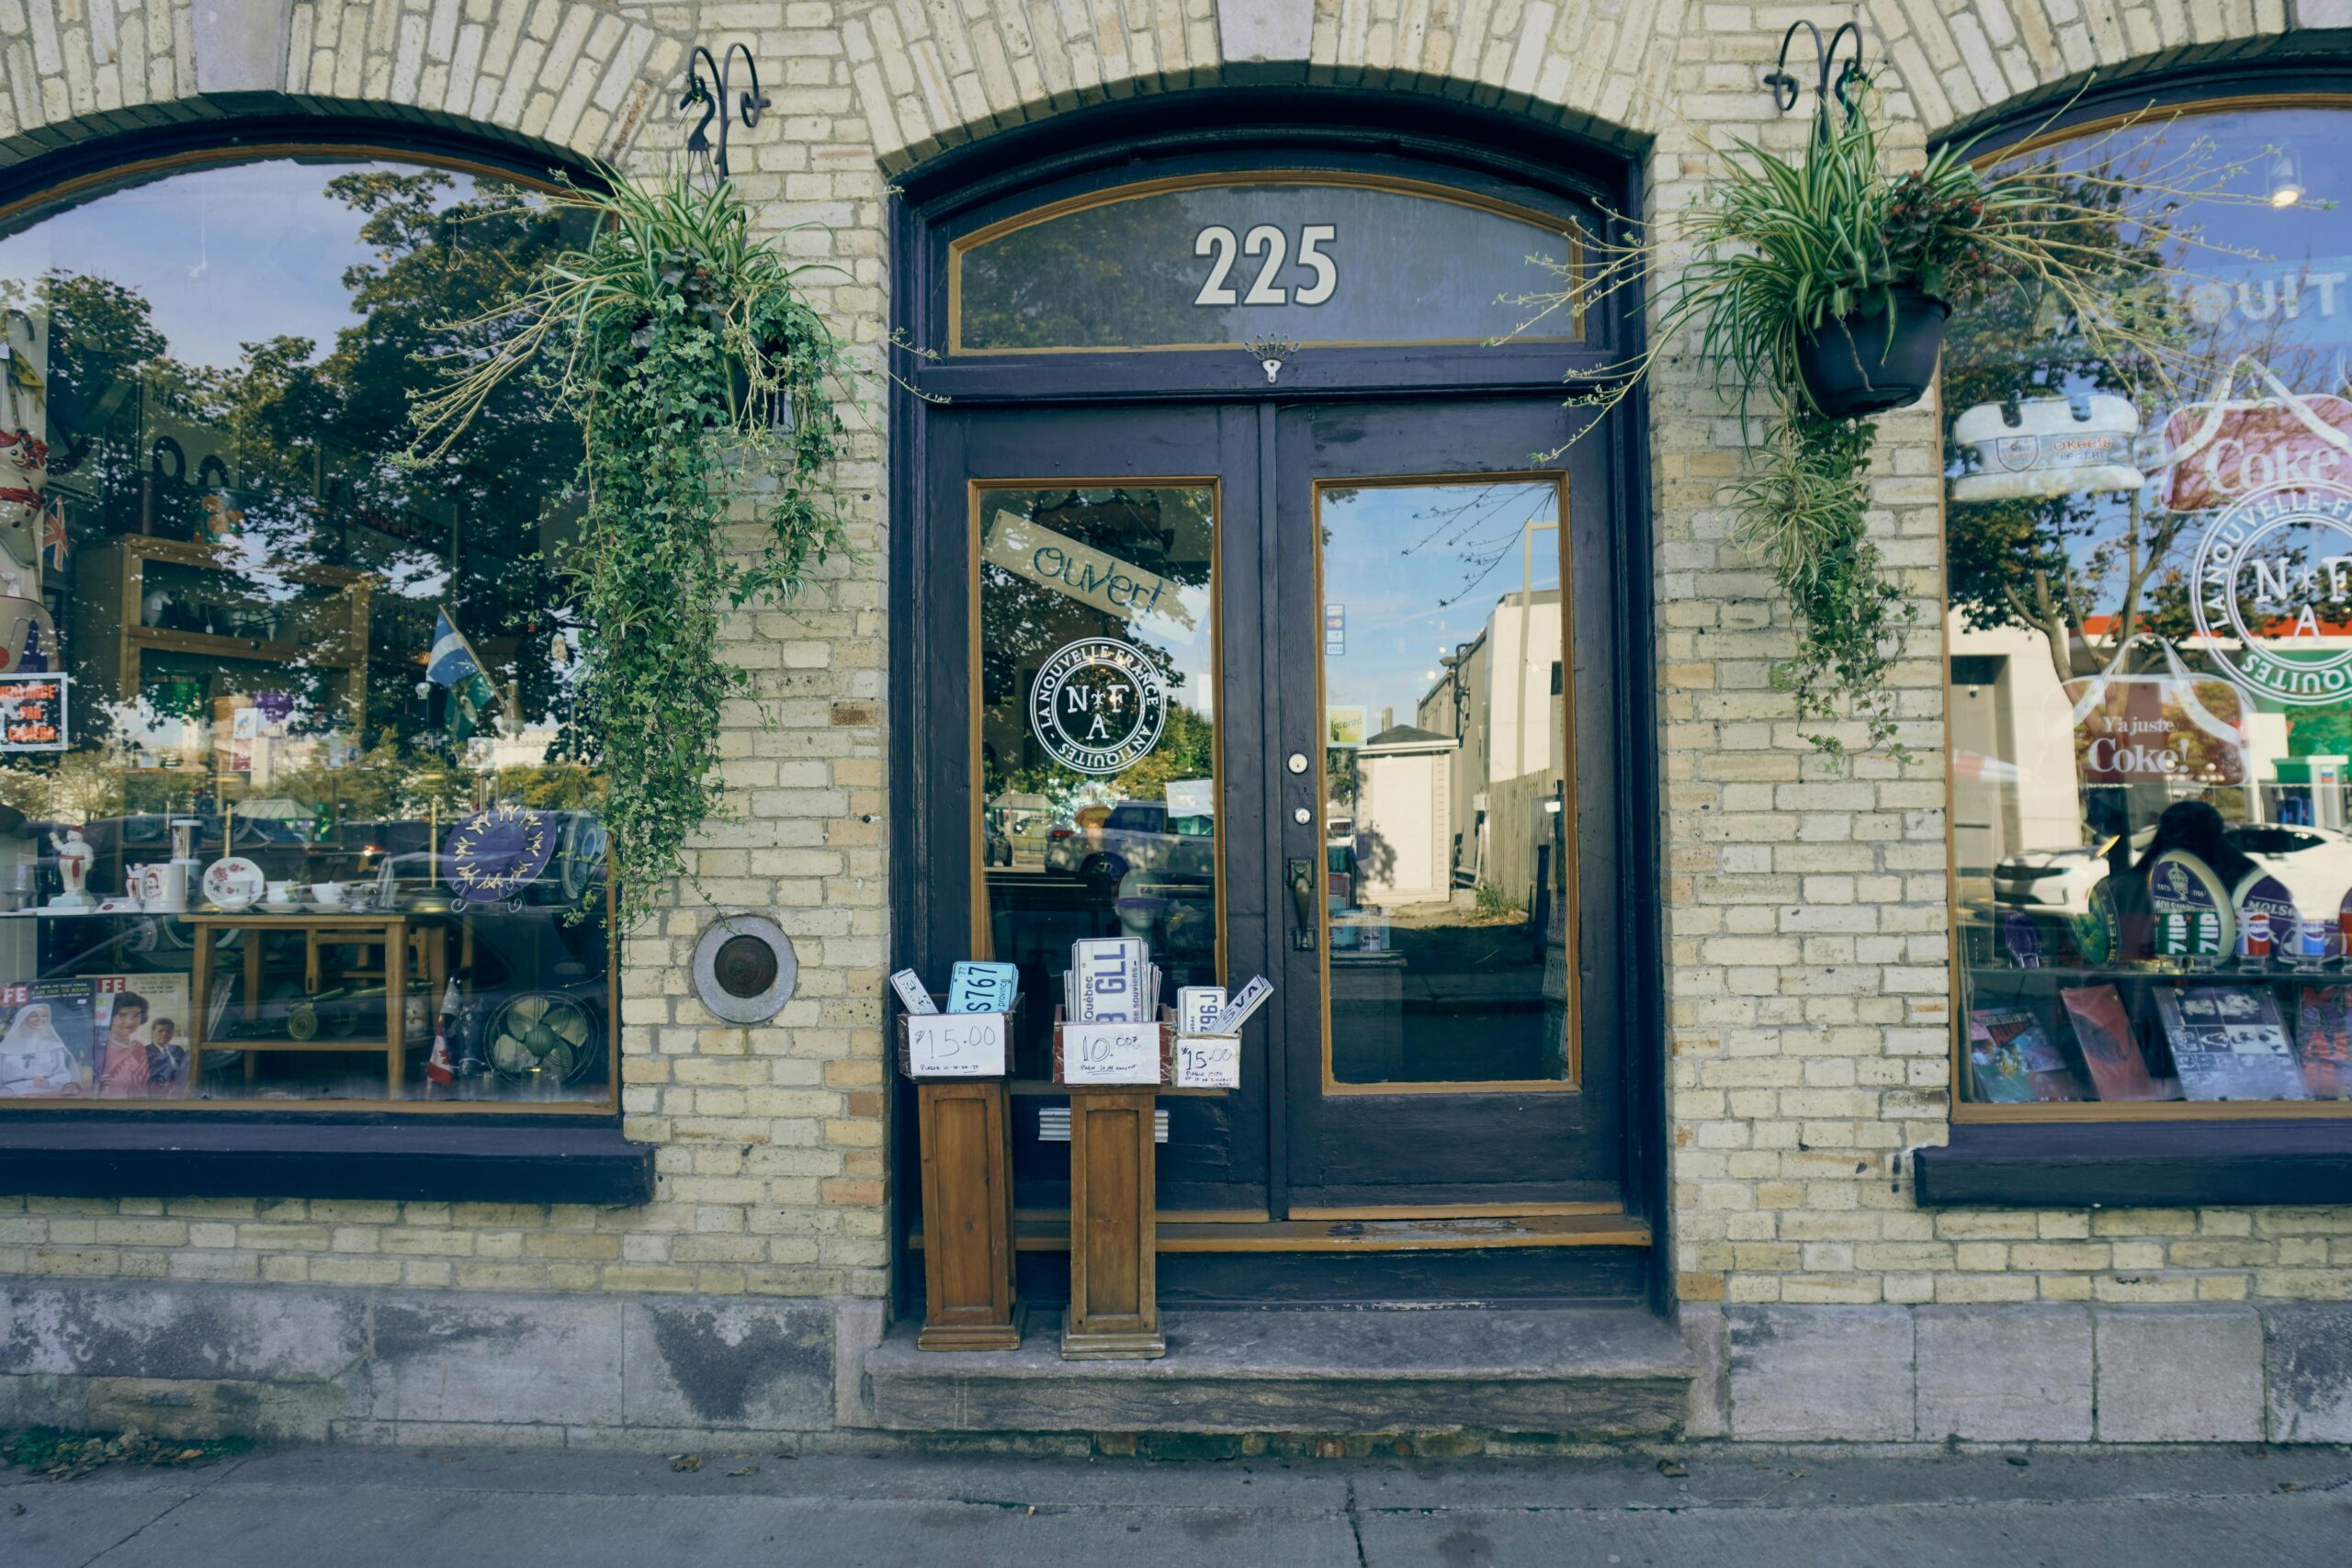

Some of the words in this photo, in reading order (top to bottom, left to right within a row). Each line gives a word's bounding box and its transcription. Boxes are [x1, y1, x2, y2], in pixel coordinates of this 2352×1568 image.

[1193, 224, 1338, 306] 225
[2286, 604, 2325, 648] A
[1085, 713, 1110, 740] A
[2130, 716, 2176, 736] juste
[2087, 737, 2190, 773] Coke!
[1093, 943, 1126, 994] GLL
[965, 966, 997, 1012] S767
[998, 978, 1007, 1008] province
[1084, 976, 1093, 1019] Québec
[914, 1024, 996, 1059] $15.00
[1181, 1045, 1233, 1071] $15.00
